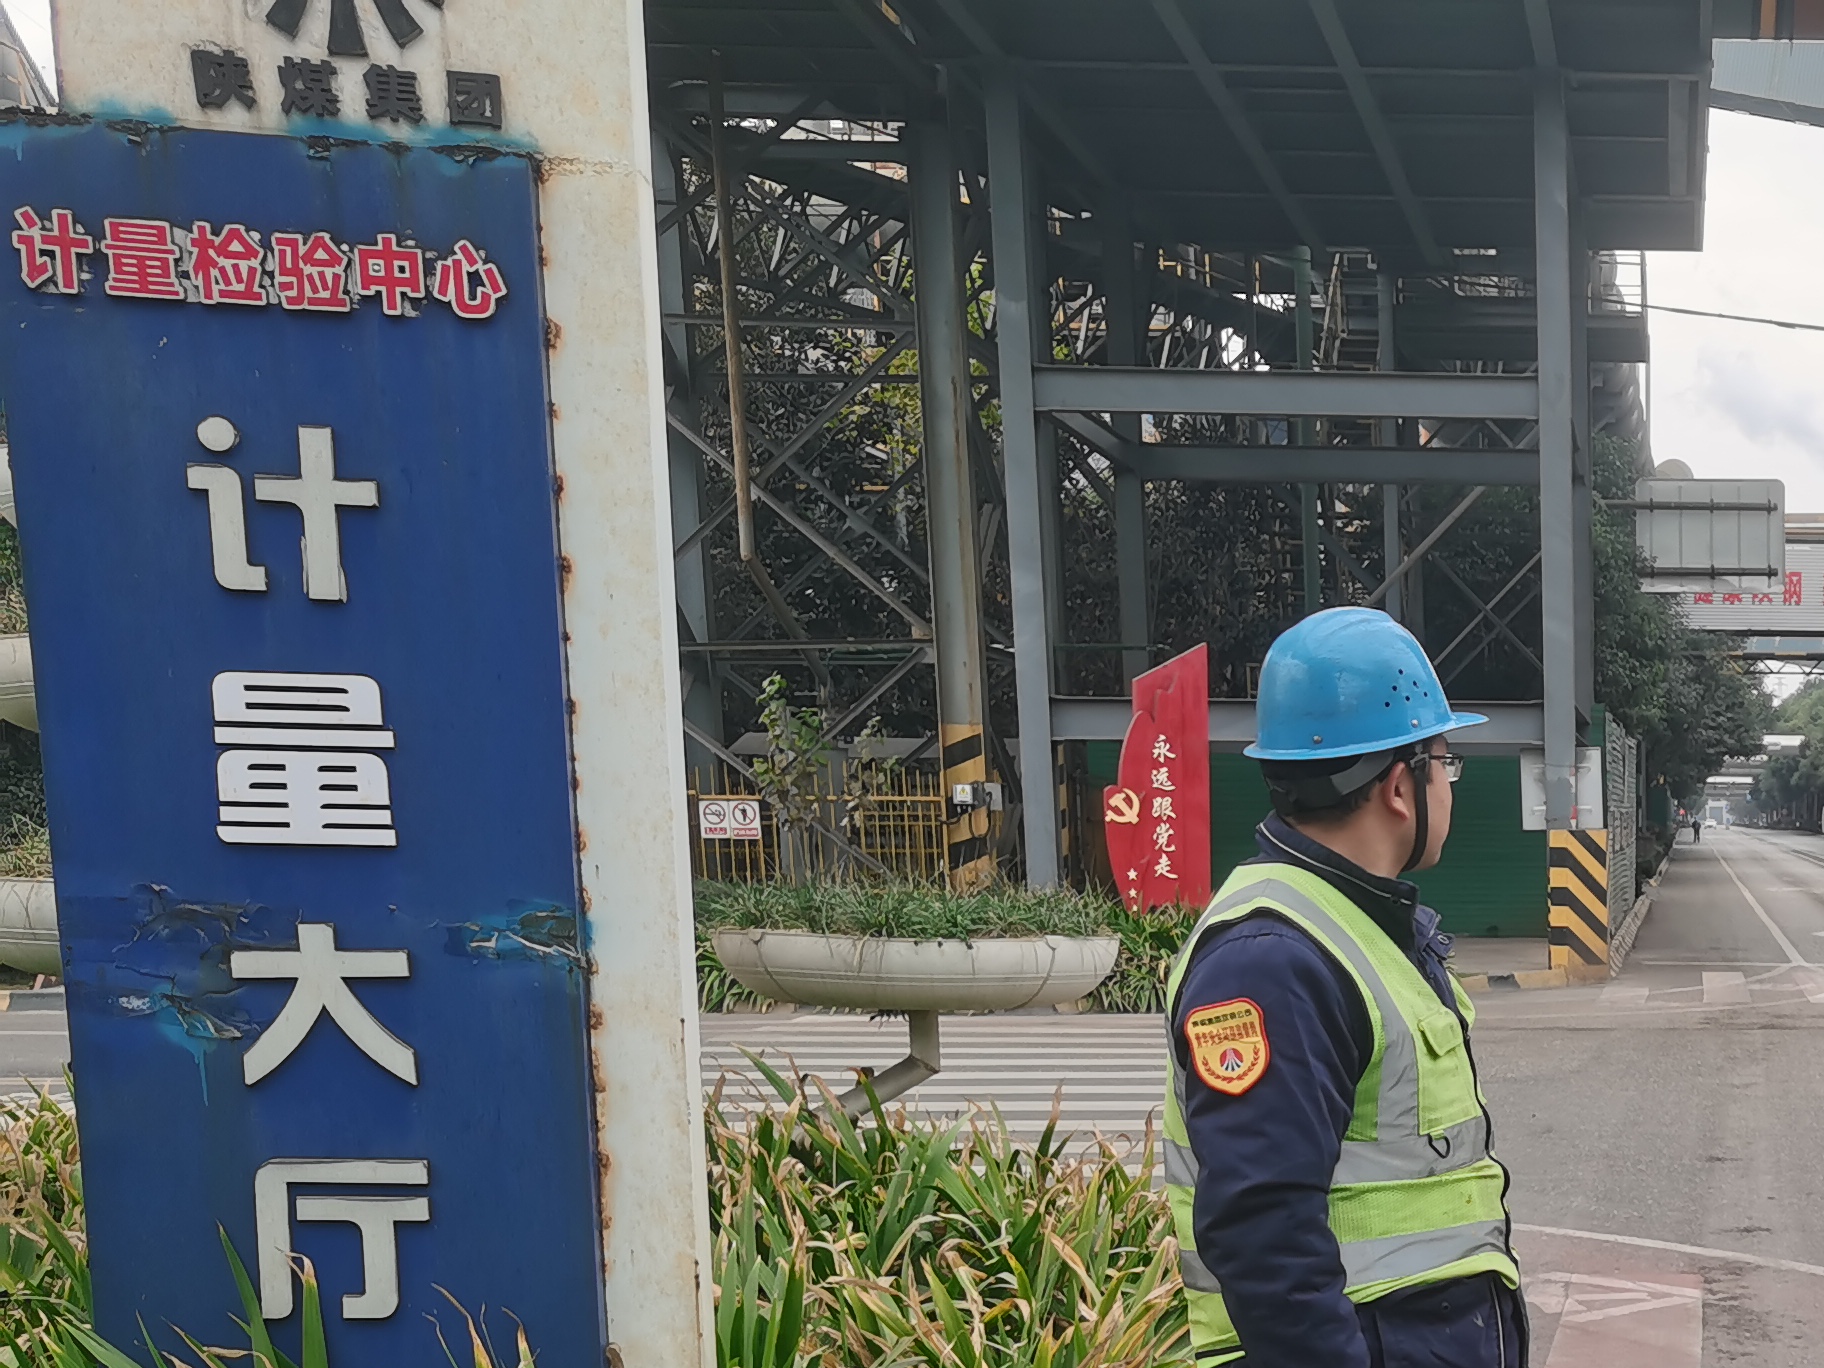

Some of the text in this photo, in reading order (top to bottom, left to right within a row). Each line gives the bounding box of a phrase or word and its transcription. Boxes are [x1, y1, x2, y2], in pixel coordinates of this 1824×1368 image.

[190, 49, 503, 130] 陕煤集团
[12, 205, 507, 320] 计量检验中心
[186, 415, 431, 1321] 计量大厅
[1151, 734, 1179, 879] 永远跟党走
